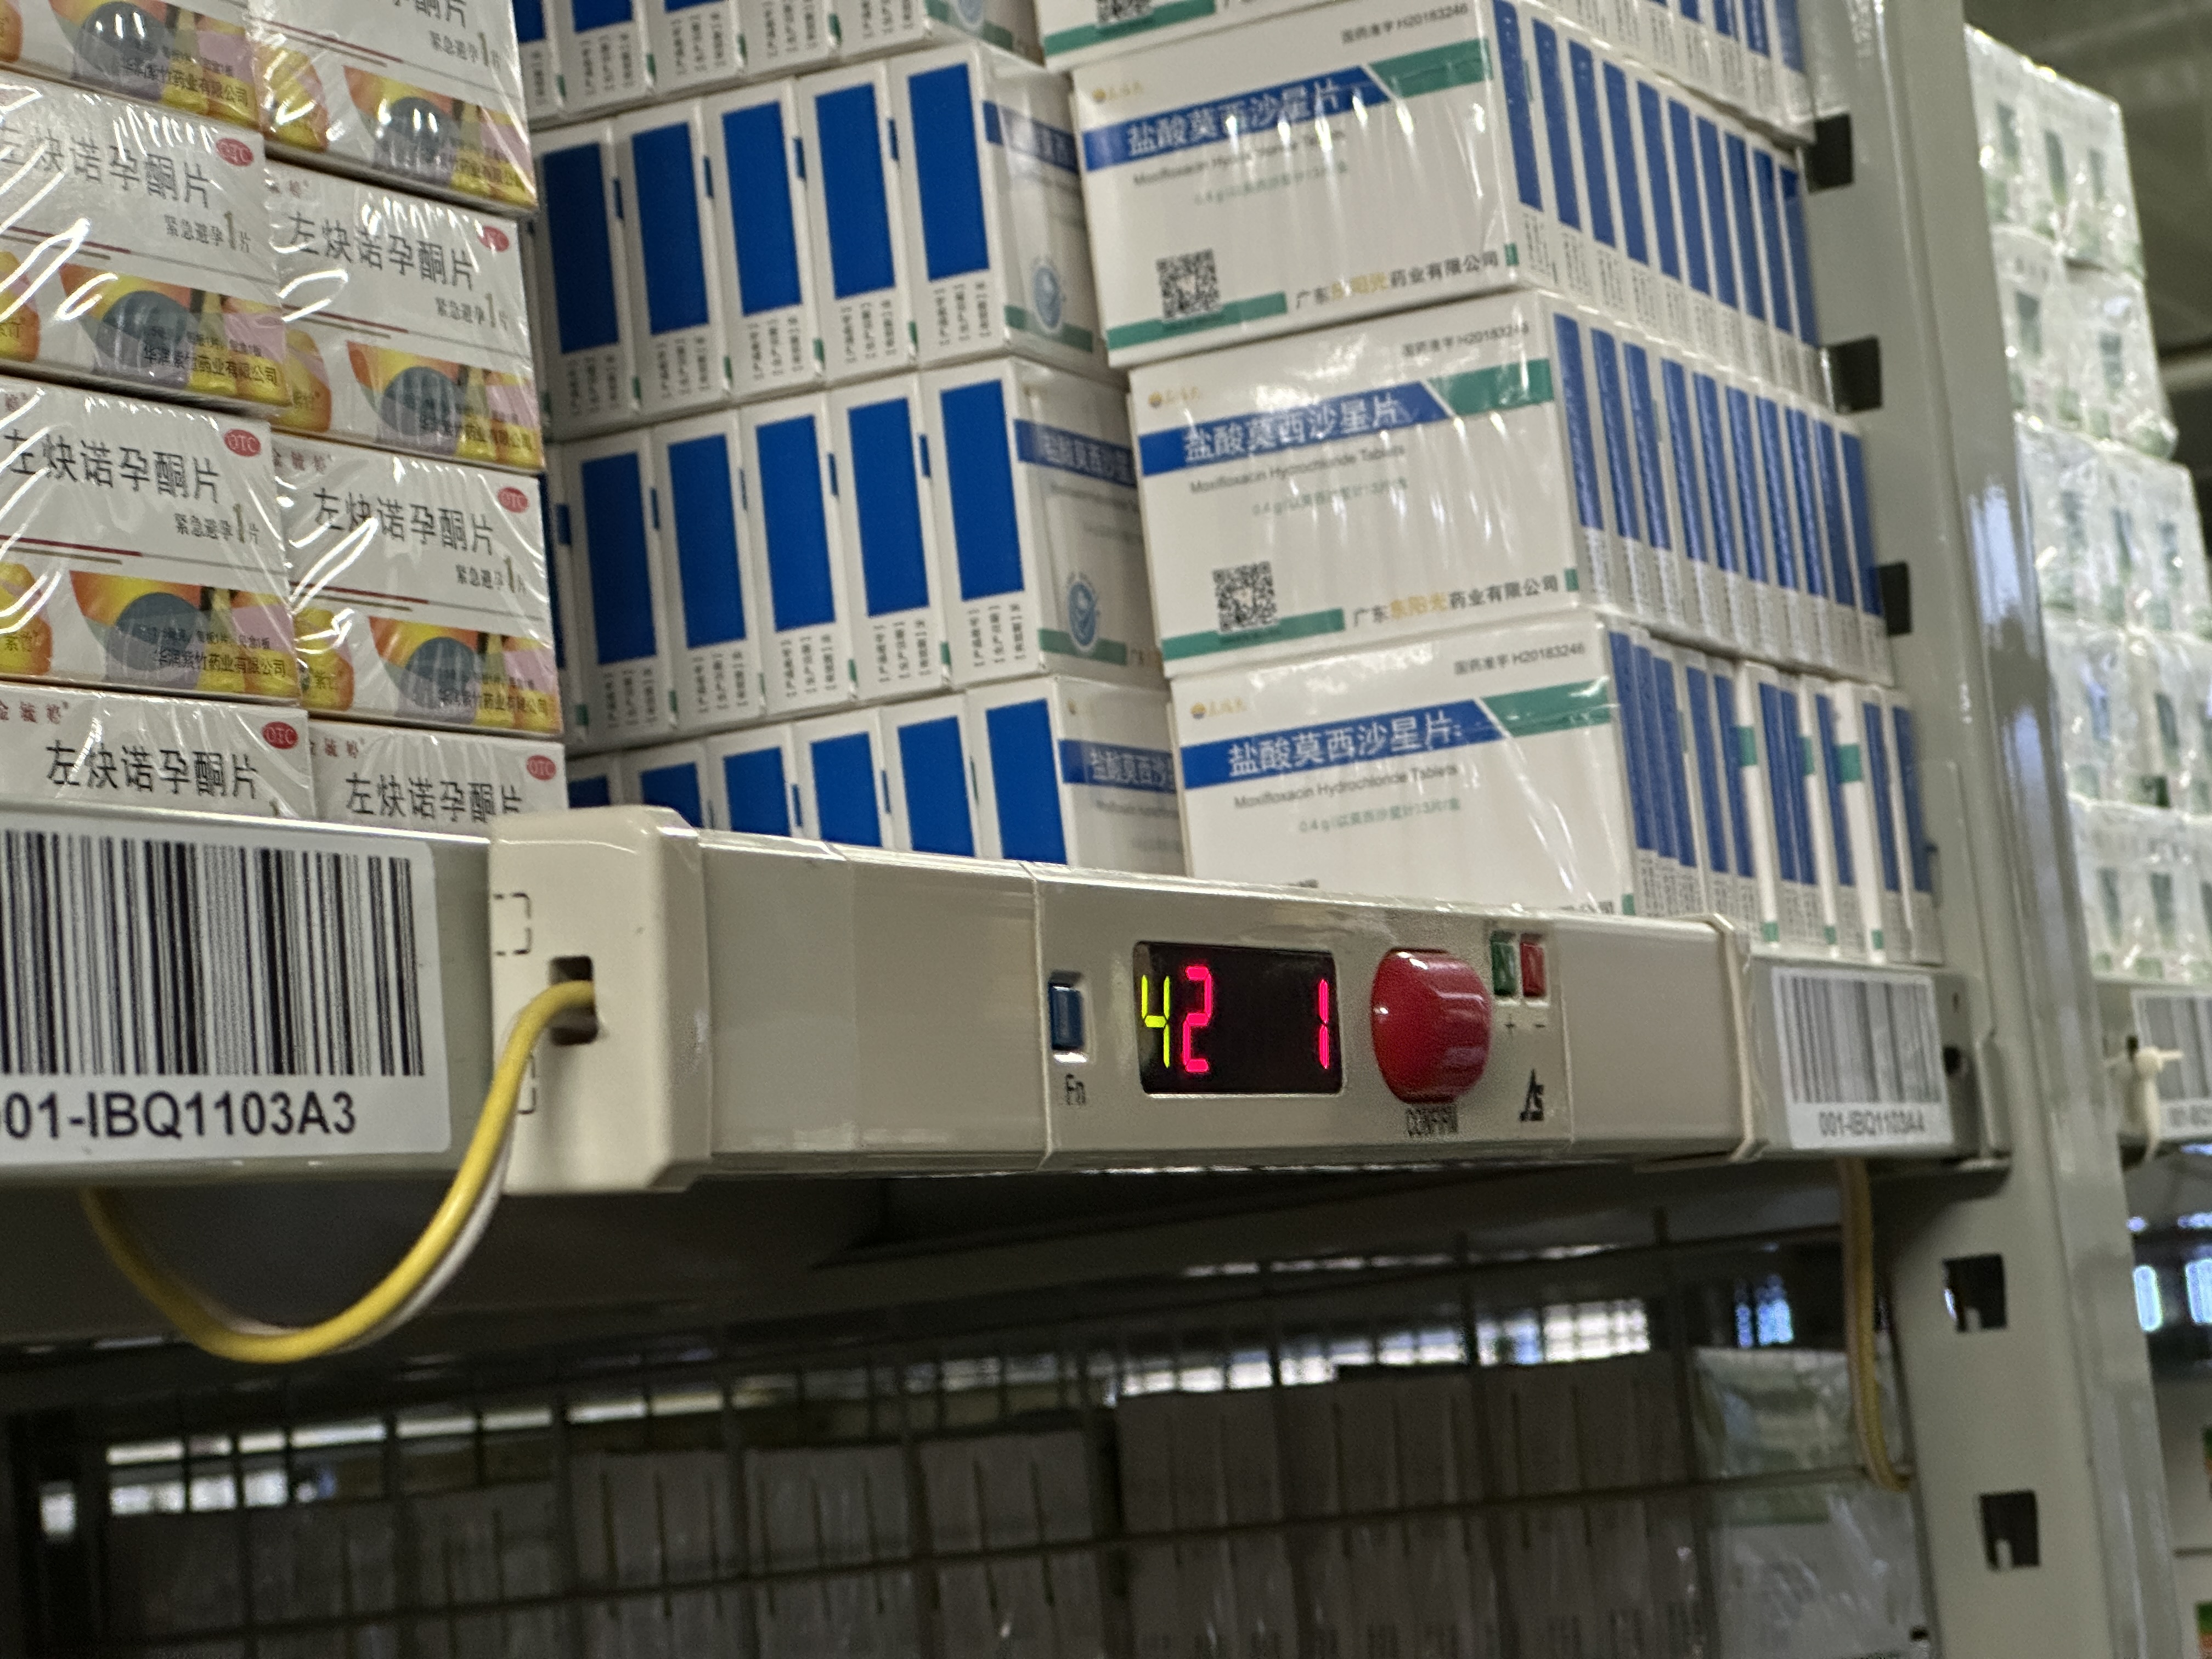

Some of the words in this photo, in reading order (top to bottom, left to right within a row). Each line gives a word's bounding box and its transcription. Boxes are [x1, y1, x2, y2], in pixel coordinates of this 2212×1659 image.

[225, 430, 259, 454] OTC
[1184, 391, 1400, 464] 盐酸莫西沙星片
[4, 428, 219, 504] 左炔诺孕酮片
[313, 487, 493, 555] 左炔诺孕酮片
[264, 725, 296, 746] OTC
[1229, 710, 1452, 778] 盐酸莫西沙星片
[46, 740, 259, 801] 左炔诺孕酮片
[346, 771, 524, 823] 左炔诺孕酮片
[1318, 978, 1330, 1070] 1
